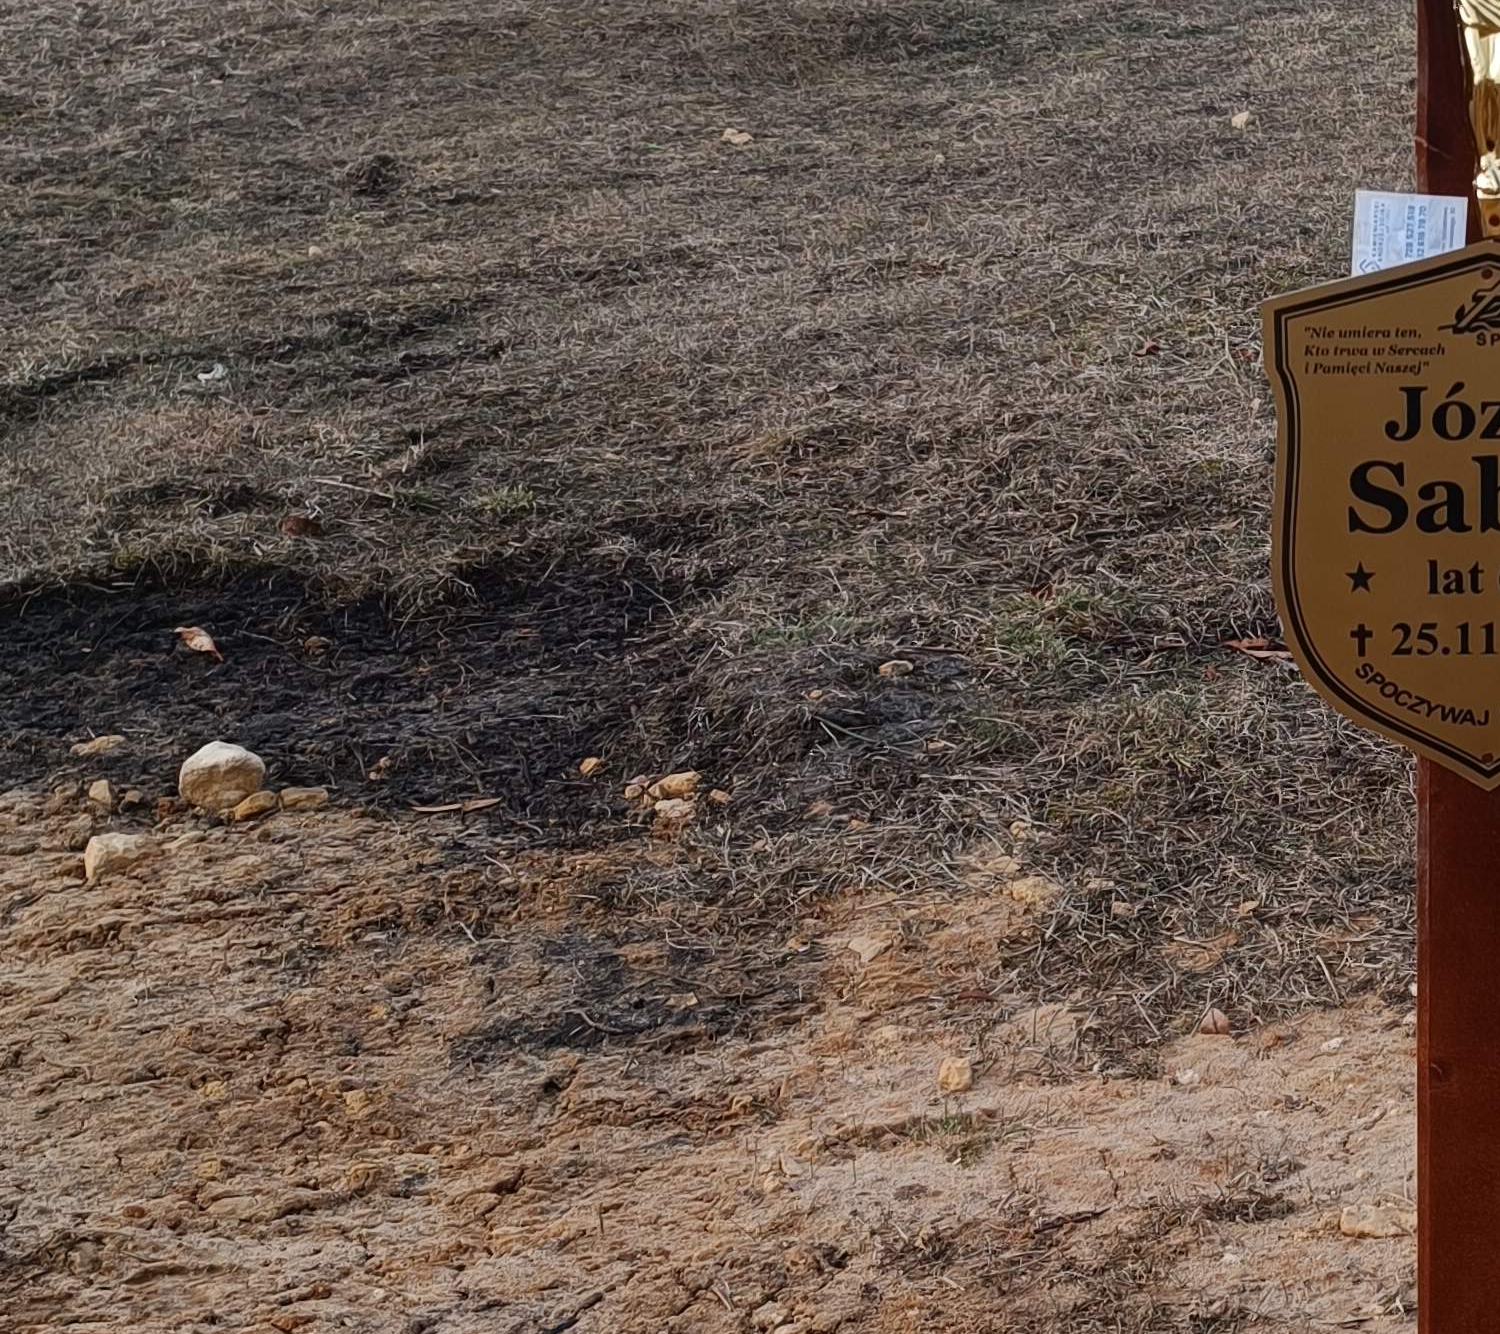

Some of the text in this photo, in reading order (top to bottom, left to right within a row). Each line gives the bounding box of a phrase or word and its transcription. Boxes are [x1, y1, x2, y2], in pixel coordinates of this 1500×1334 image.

[1305, 326, 1421, 339] "Nie umiera ten,
[1305, 343, 1445, 356] Kto trwa w Sercach
[1313, 362, 1370, 376] Pamięci
[1374, 361, 1429, 376] Naszej"
[1428, 560, 1484, 594] lat
[1355, 662, 1490, 727] SPOCZYWAJ
